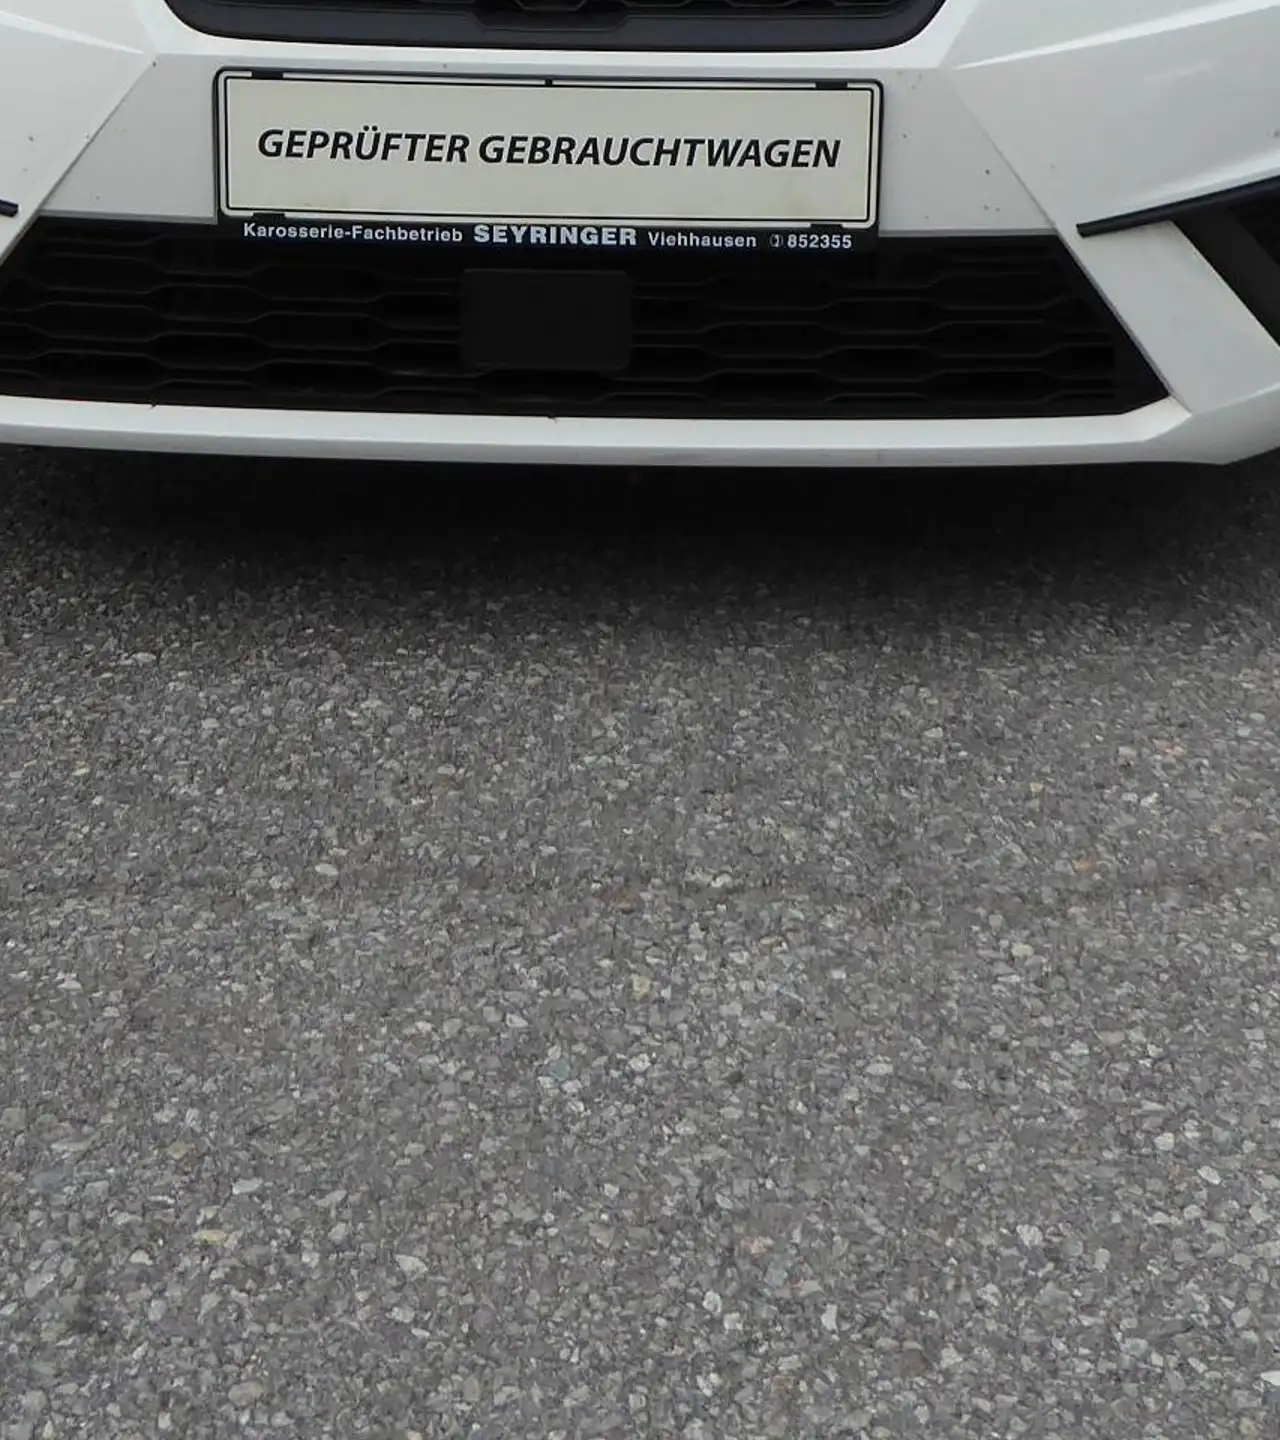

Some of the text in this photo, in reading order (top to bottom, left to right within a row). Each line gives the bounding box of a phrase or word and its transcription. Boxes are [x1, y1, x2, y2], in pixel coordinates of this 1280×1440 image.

[257, 125, 841, 167] GEPRÜFTER GEBRAUCHTWAGEN
[243, 222, 852, 249] Karosserie-Fachbetrieb SEYRINGER Viehhausen 852355
